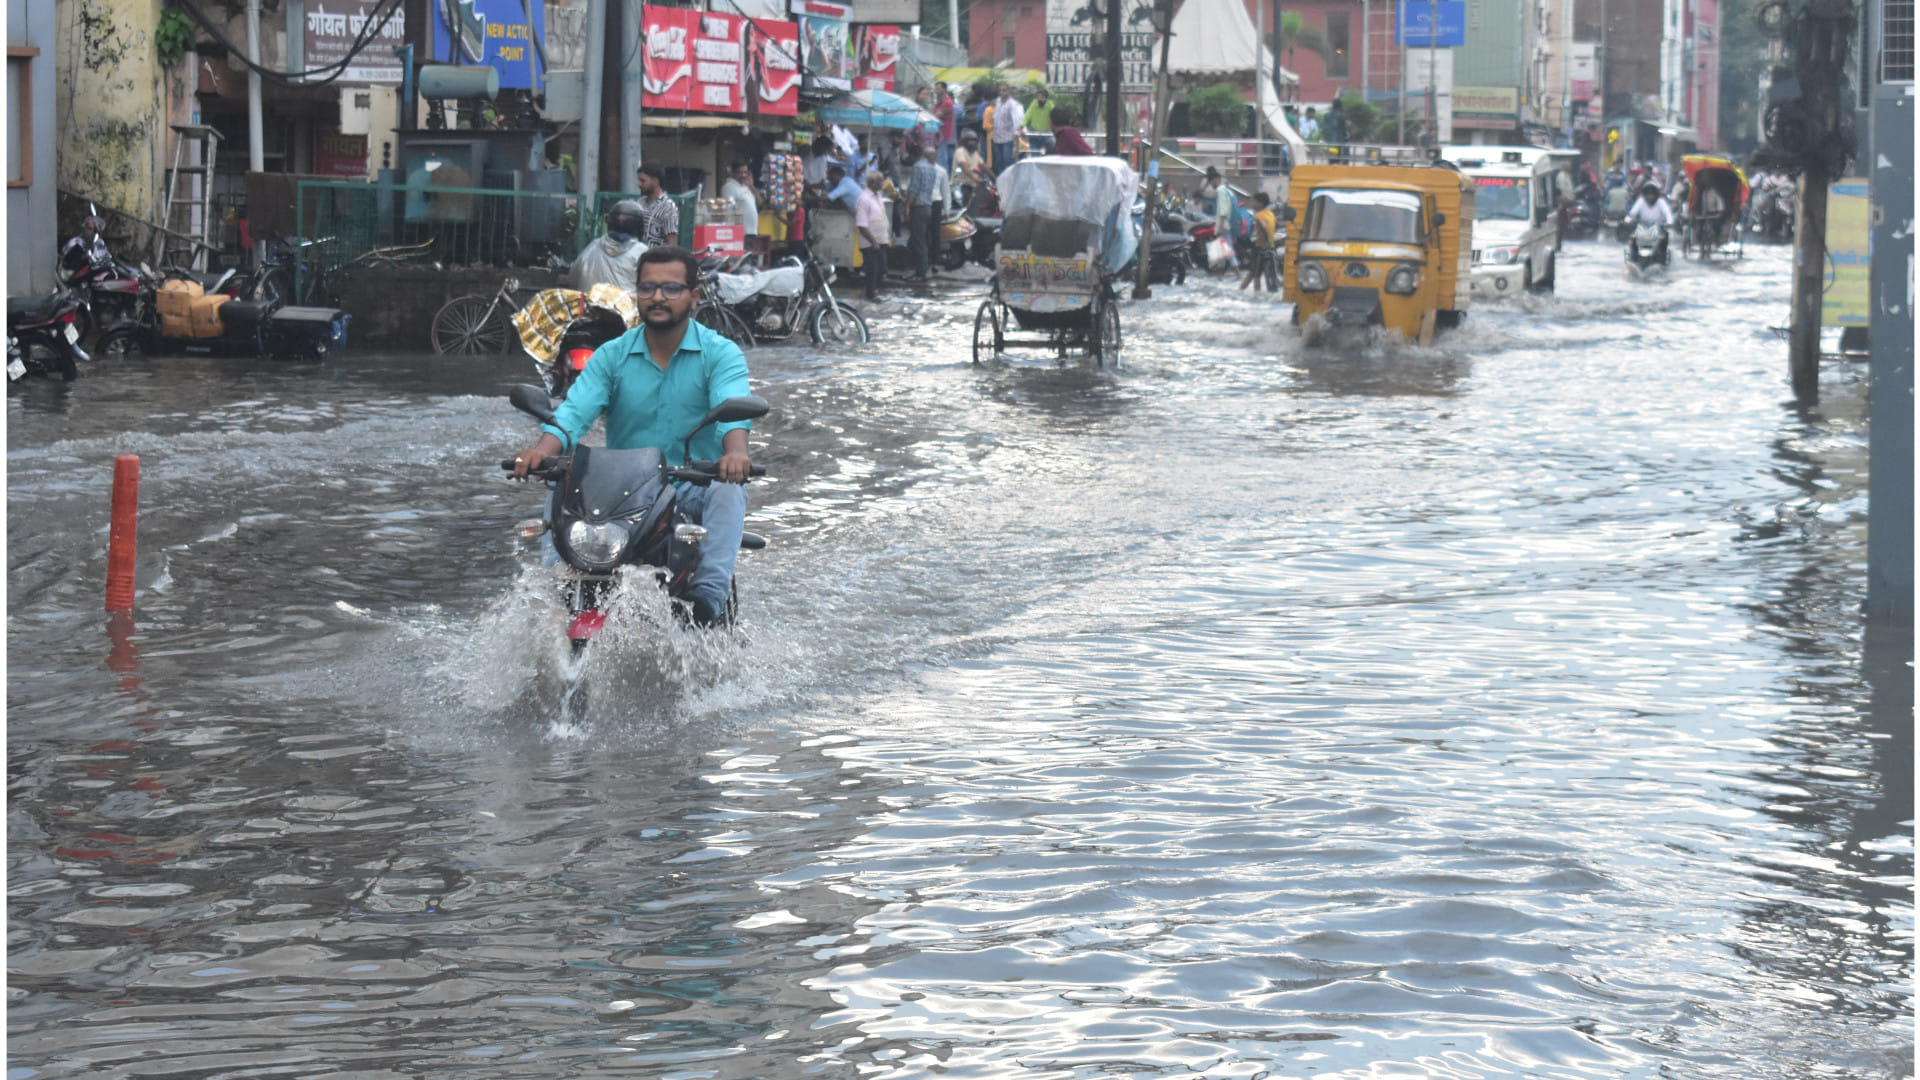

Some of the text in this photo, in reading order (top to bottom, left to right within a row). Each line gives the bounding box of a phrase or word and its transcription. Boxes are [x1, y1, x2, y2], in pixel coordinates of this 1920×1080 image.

[308, 4, 347, 36] गोयल
[487, 23, 505, 38] NEW
[500, 46, 524, 61] POINT
